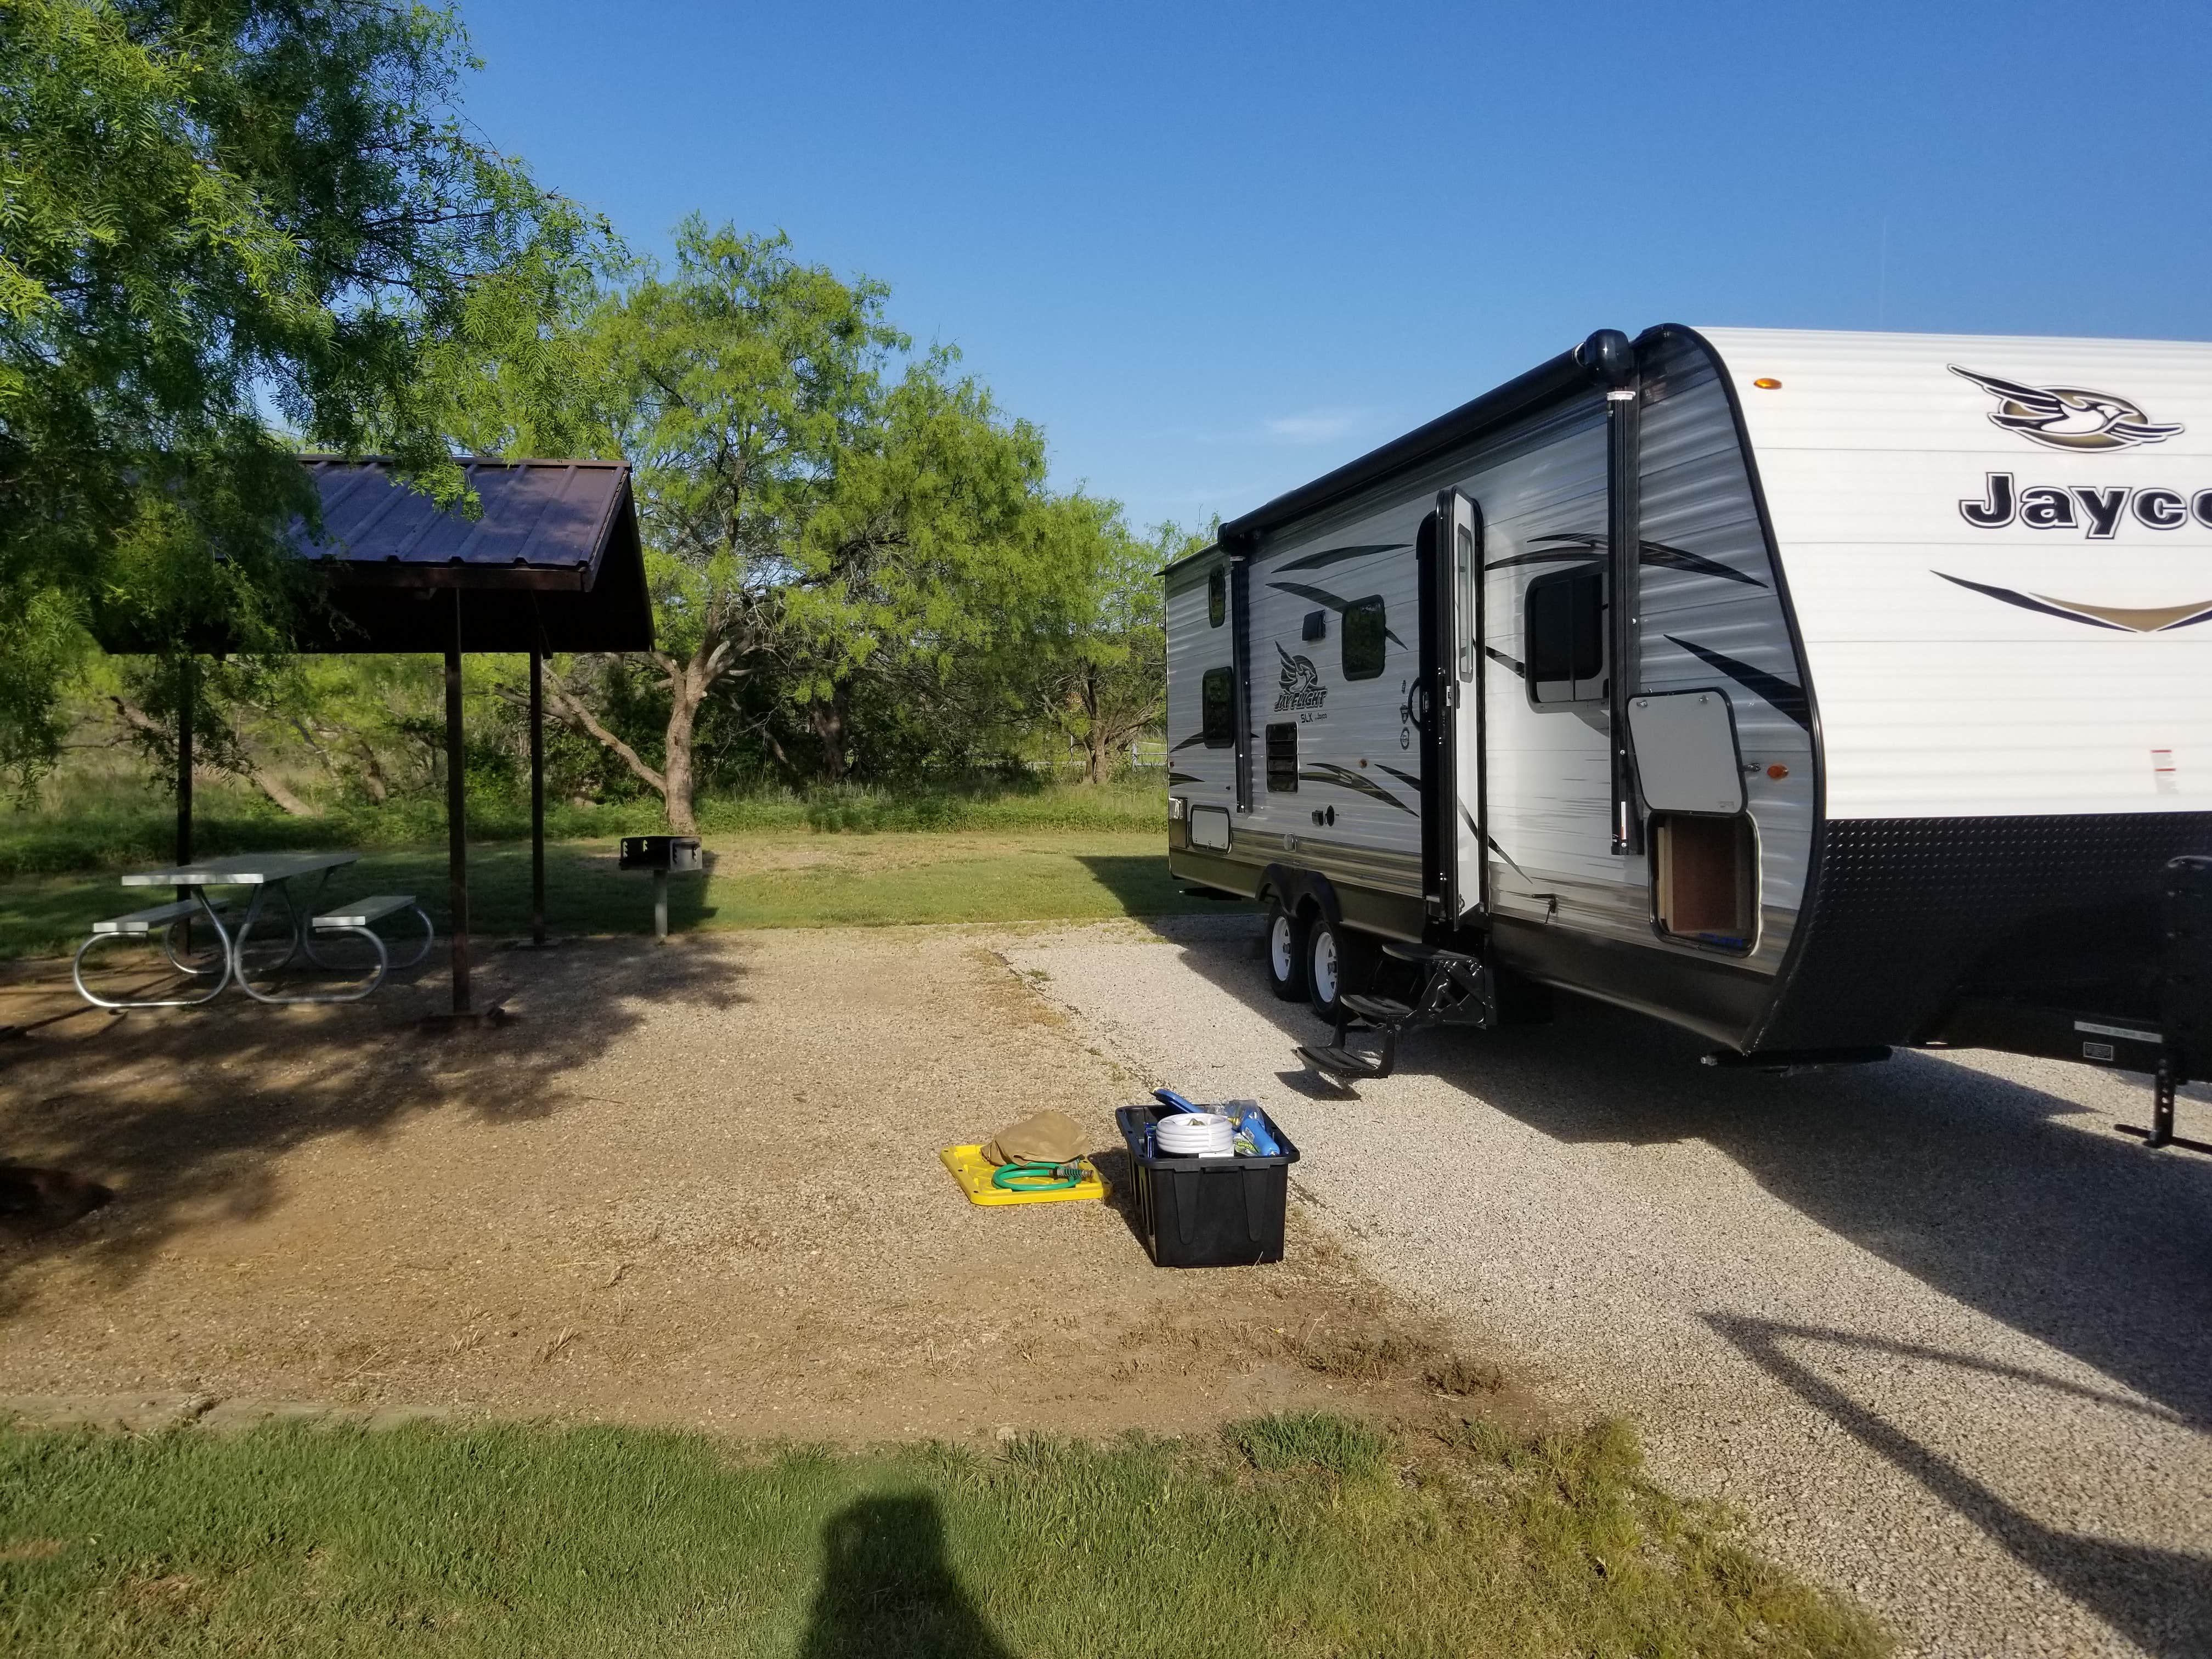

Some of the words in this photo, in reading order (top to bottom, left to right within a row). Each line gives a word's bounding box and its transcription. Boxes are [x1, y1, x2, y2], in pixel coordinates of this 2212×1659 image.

[1274, 693, 1294, 712] JAY
[1290, 689, 1327, 710] FLIGHT
[1300, 713, 1313, 723] SLX
